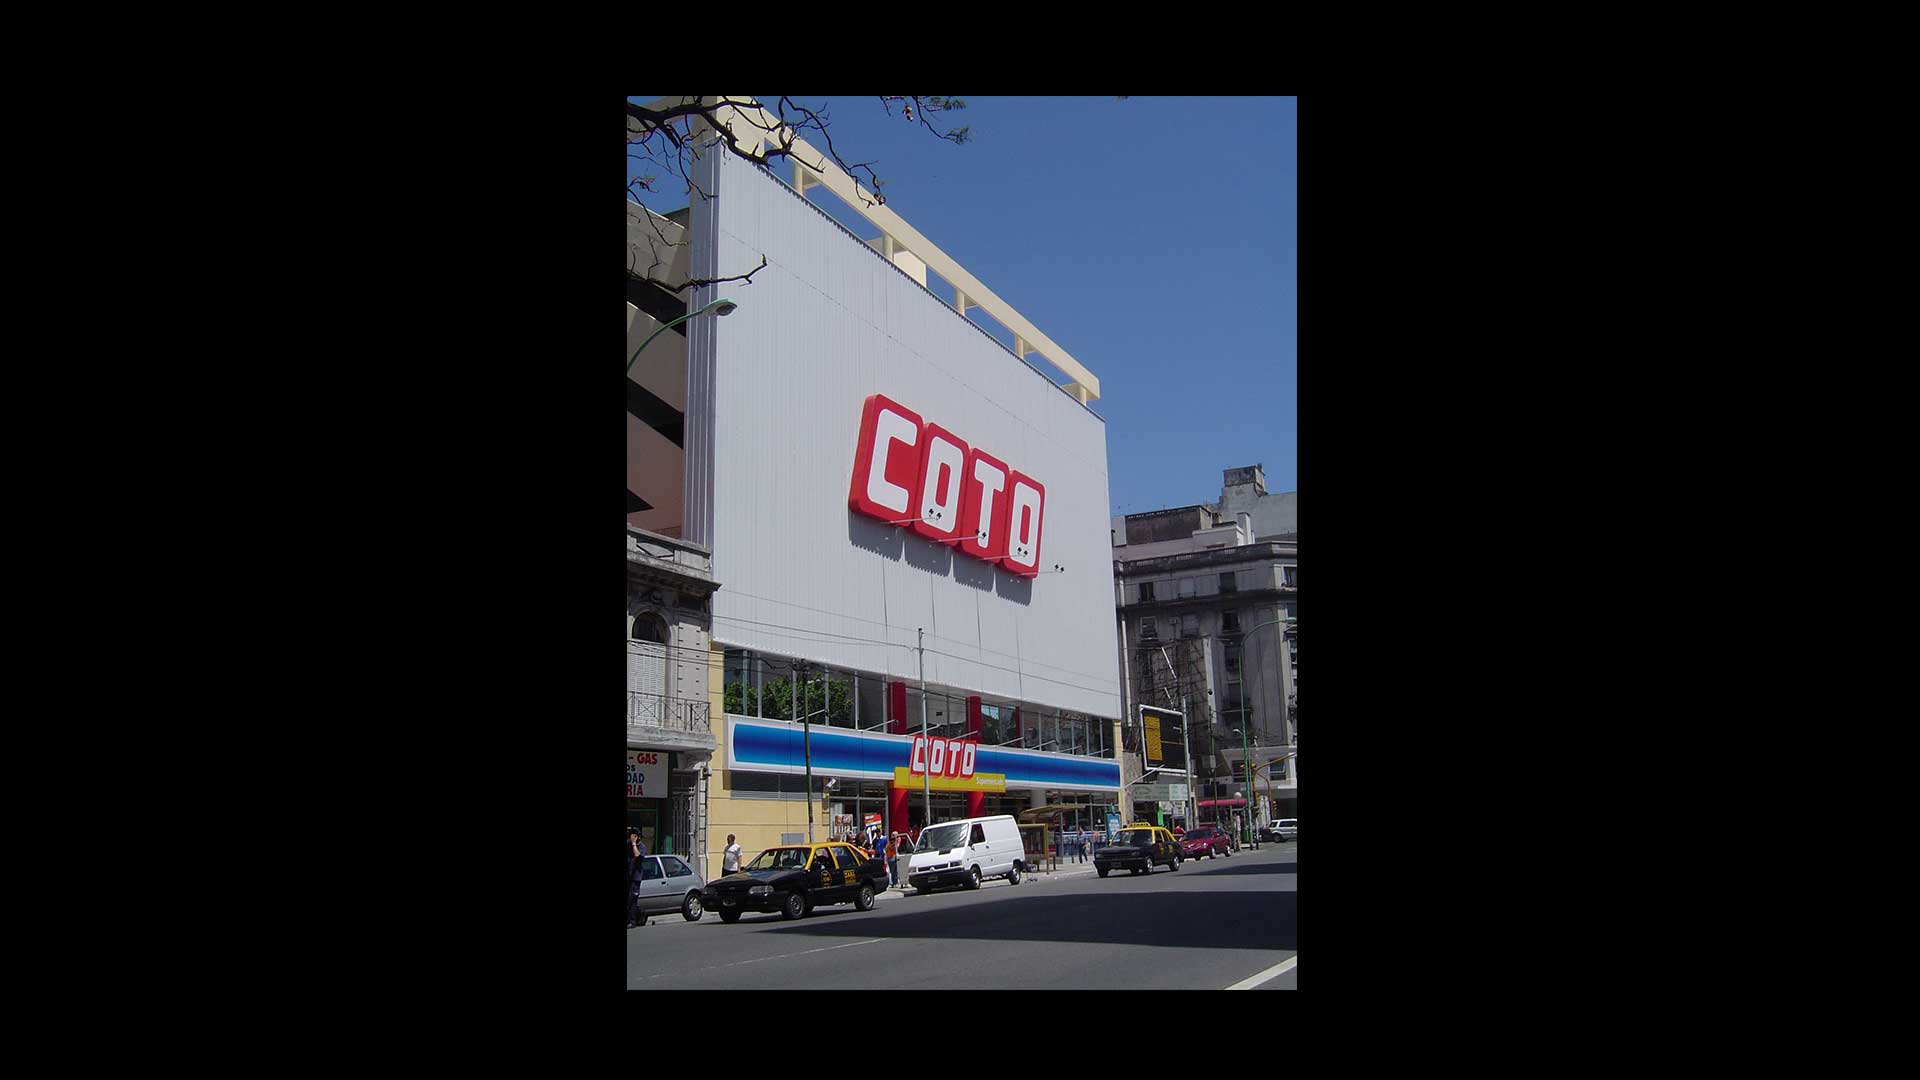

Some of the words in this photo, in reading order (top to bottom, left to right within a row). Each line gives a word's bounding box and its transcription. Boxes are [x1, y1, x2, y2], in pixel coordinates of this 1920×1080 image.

[866, 407, 1042, 567] COTO
[637, 752, 658, 765] GAS
[912, 737, 976, 775] COTO
[627, 784, 643, 796] RIA
